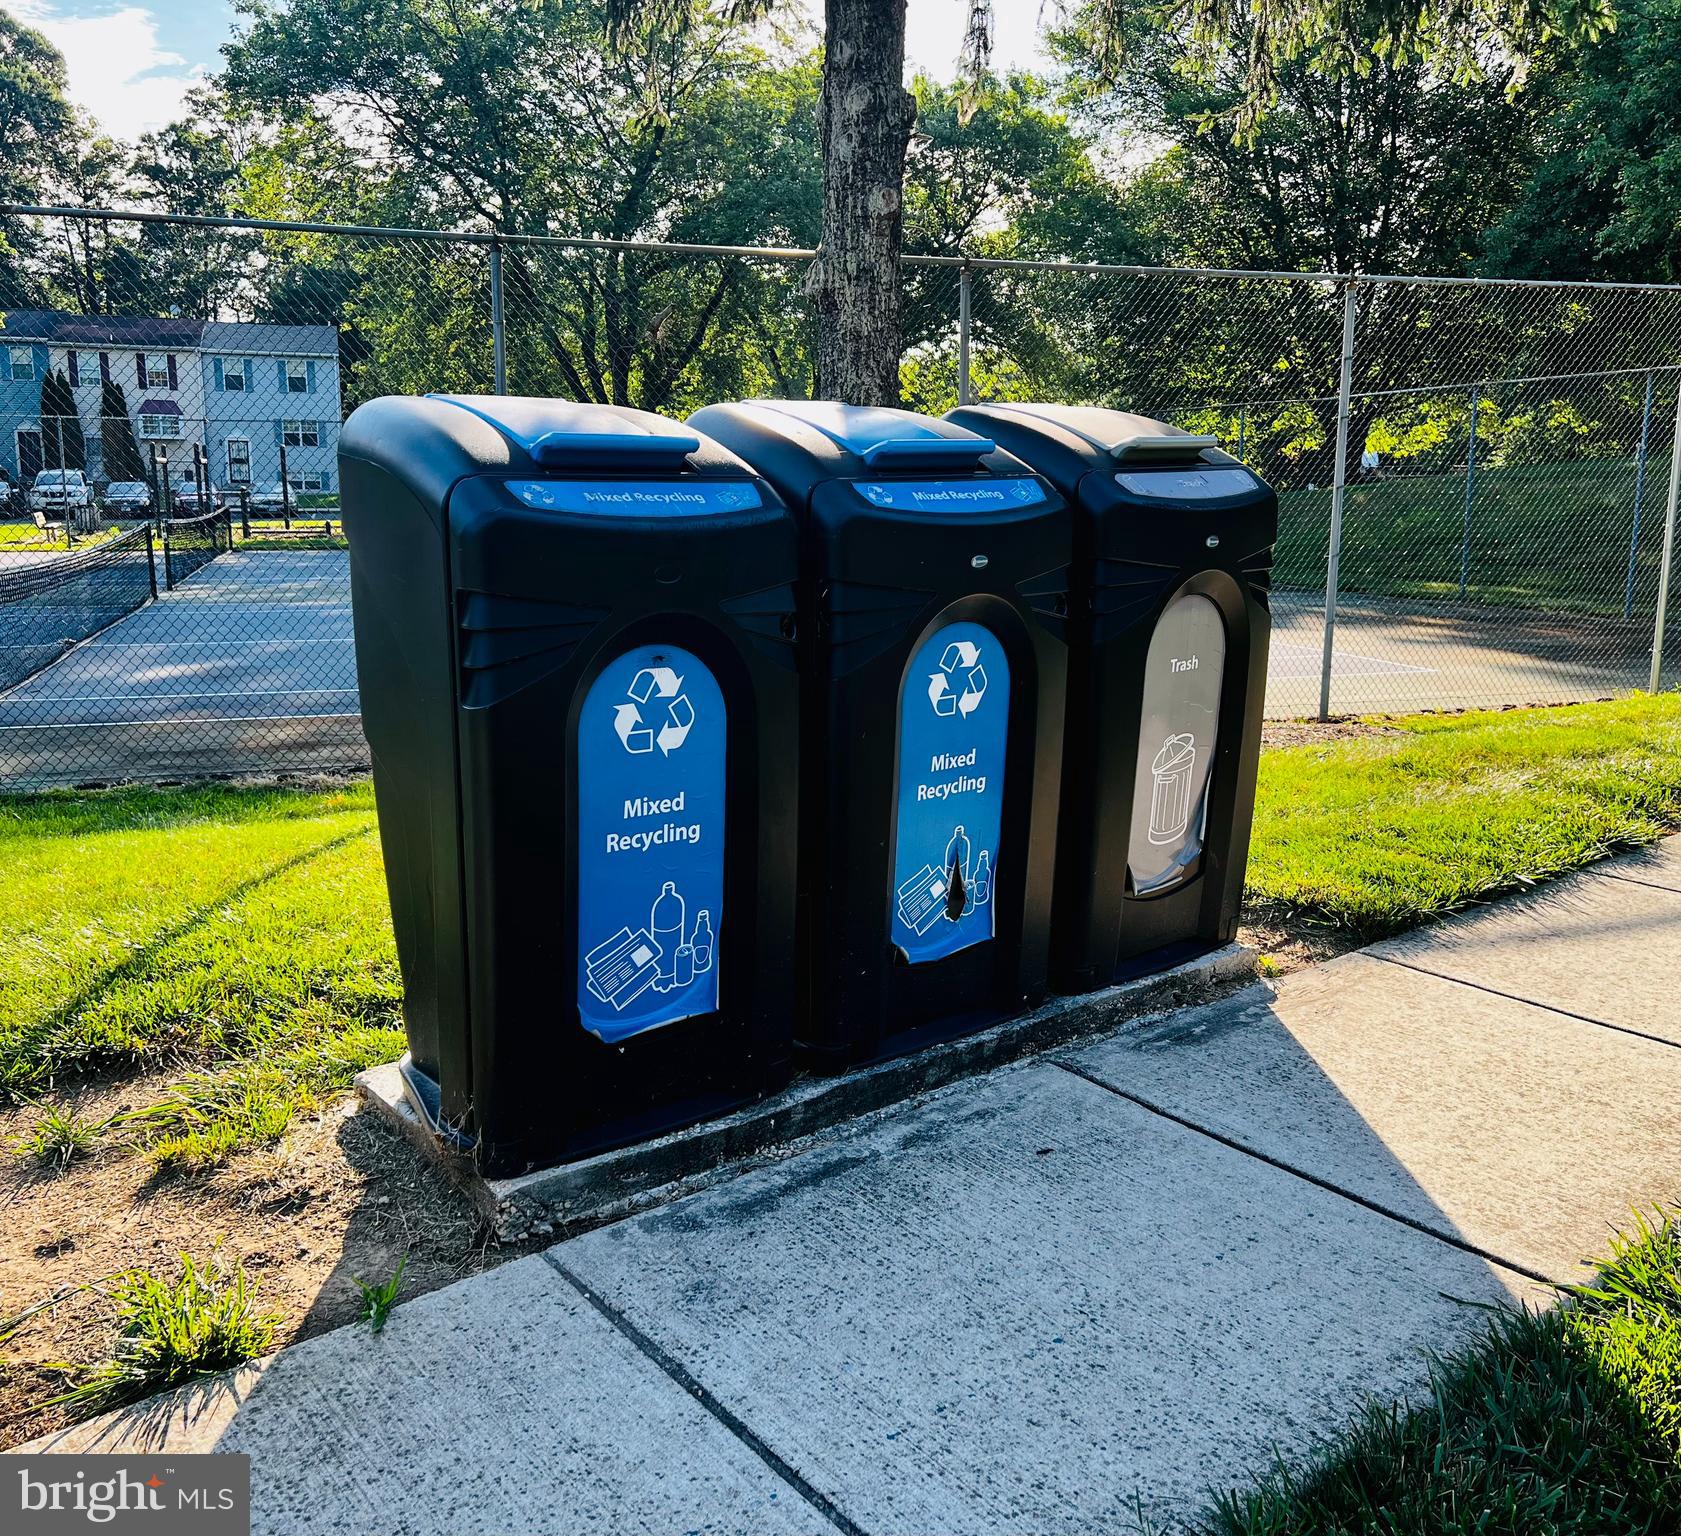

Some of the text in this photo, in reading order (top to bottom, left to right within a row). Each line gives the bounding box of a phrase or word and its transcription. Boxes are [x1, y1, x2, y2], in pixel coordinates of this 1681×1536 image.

[583, 491, 706, 504] Mixed Recycling
[912, 489, 1005, 501] Mixed Recycling
[1170, 655, 1198, 673] Trash
[931, 748, 977, 772] Mixed
[917, 776, 986, 801] Recycling
[623, 791, 685, 819] Mixed
[606, 823, 701, 853] Recycling
